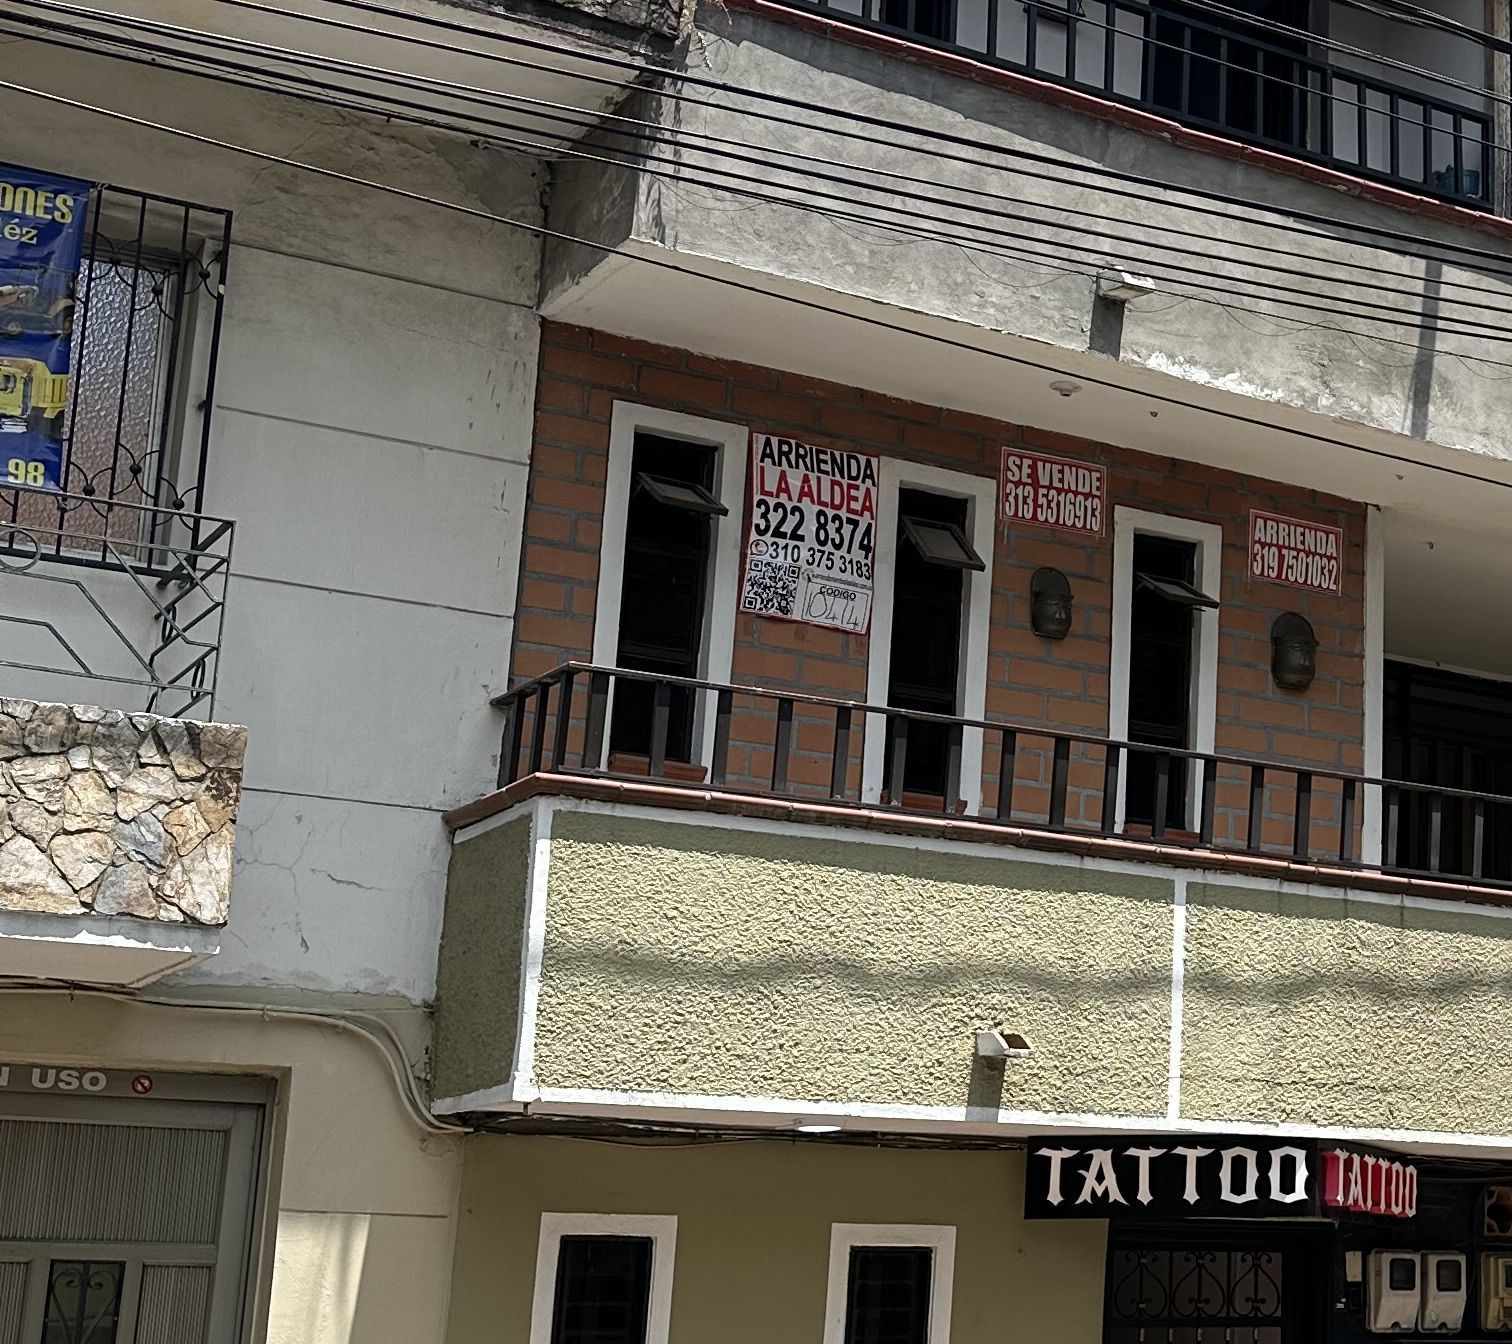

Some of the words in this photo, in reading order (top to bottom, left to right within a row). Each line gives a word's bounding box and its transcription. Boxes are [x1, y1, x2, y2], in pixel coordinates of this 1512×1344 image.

[0, 218, 38, 245] éz
[759, 436, 877, 488] ARRIENDA
[1006, 455, 1033, 483] SE
[1036, 460, 1101, 496] VENDE
[759, 465, 793, 502] LA
[797, 473, 875, 521] ALDEA
[1005, 482, 1034, 520] 313
[1036, 487, 1101, 531] 5316913
[754, 498, 806, 543] 322
[814, 508, 873, 561] 8374
[1254, 517, 1337, 557] ARRIENDA
[769, 541, 801, 564] 310
[805, 547, 835, 571] 375
[839, 555, 871, 581] 3183
[1253, 542, 1279, 579] 319
[1281, 548, 1337, 591] 7501032
[31, 1067, 108, 1091] USO
[1033, 1145, 1310, 1208] TATTOO
[1333, 1147, 1419, 1218] TATTOO
